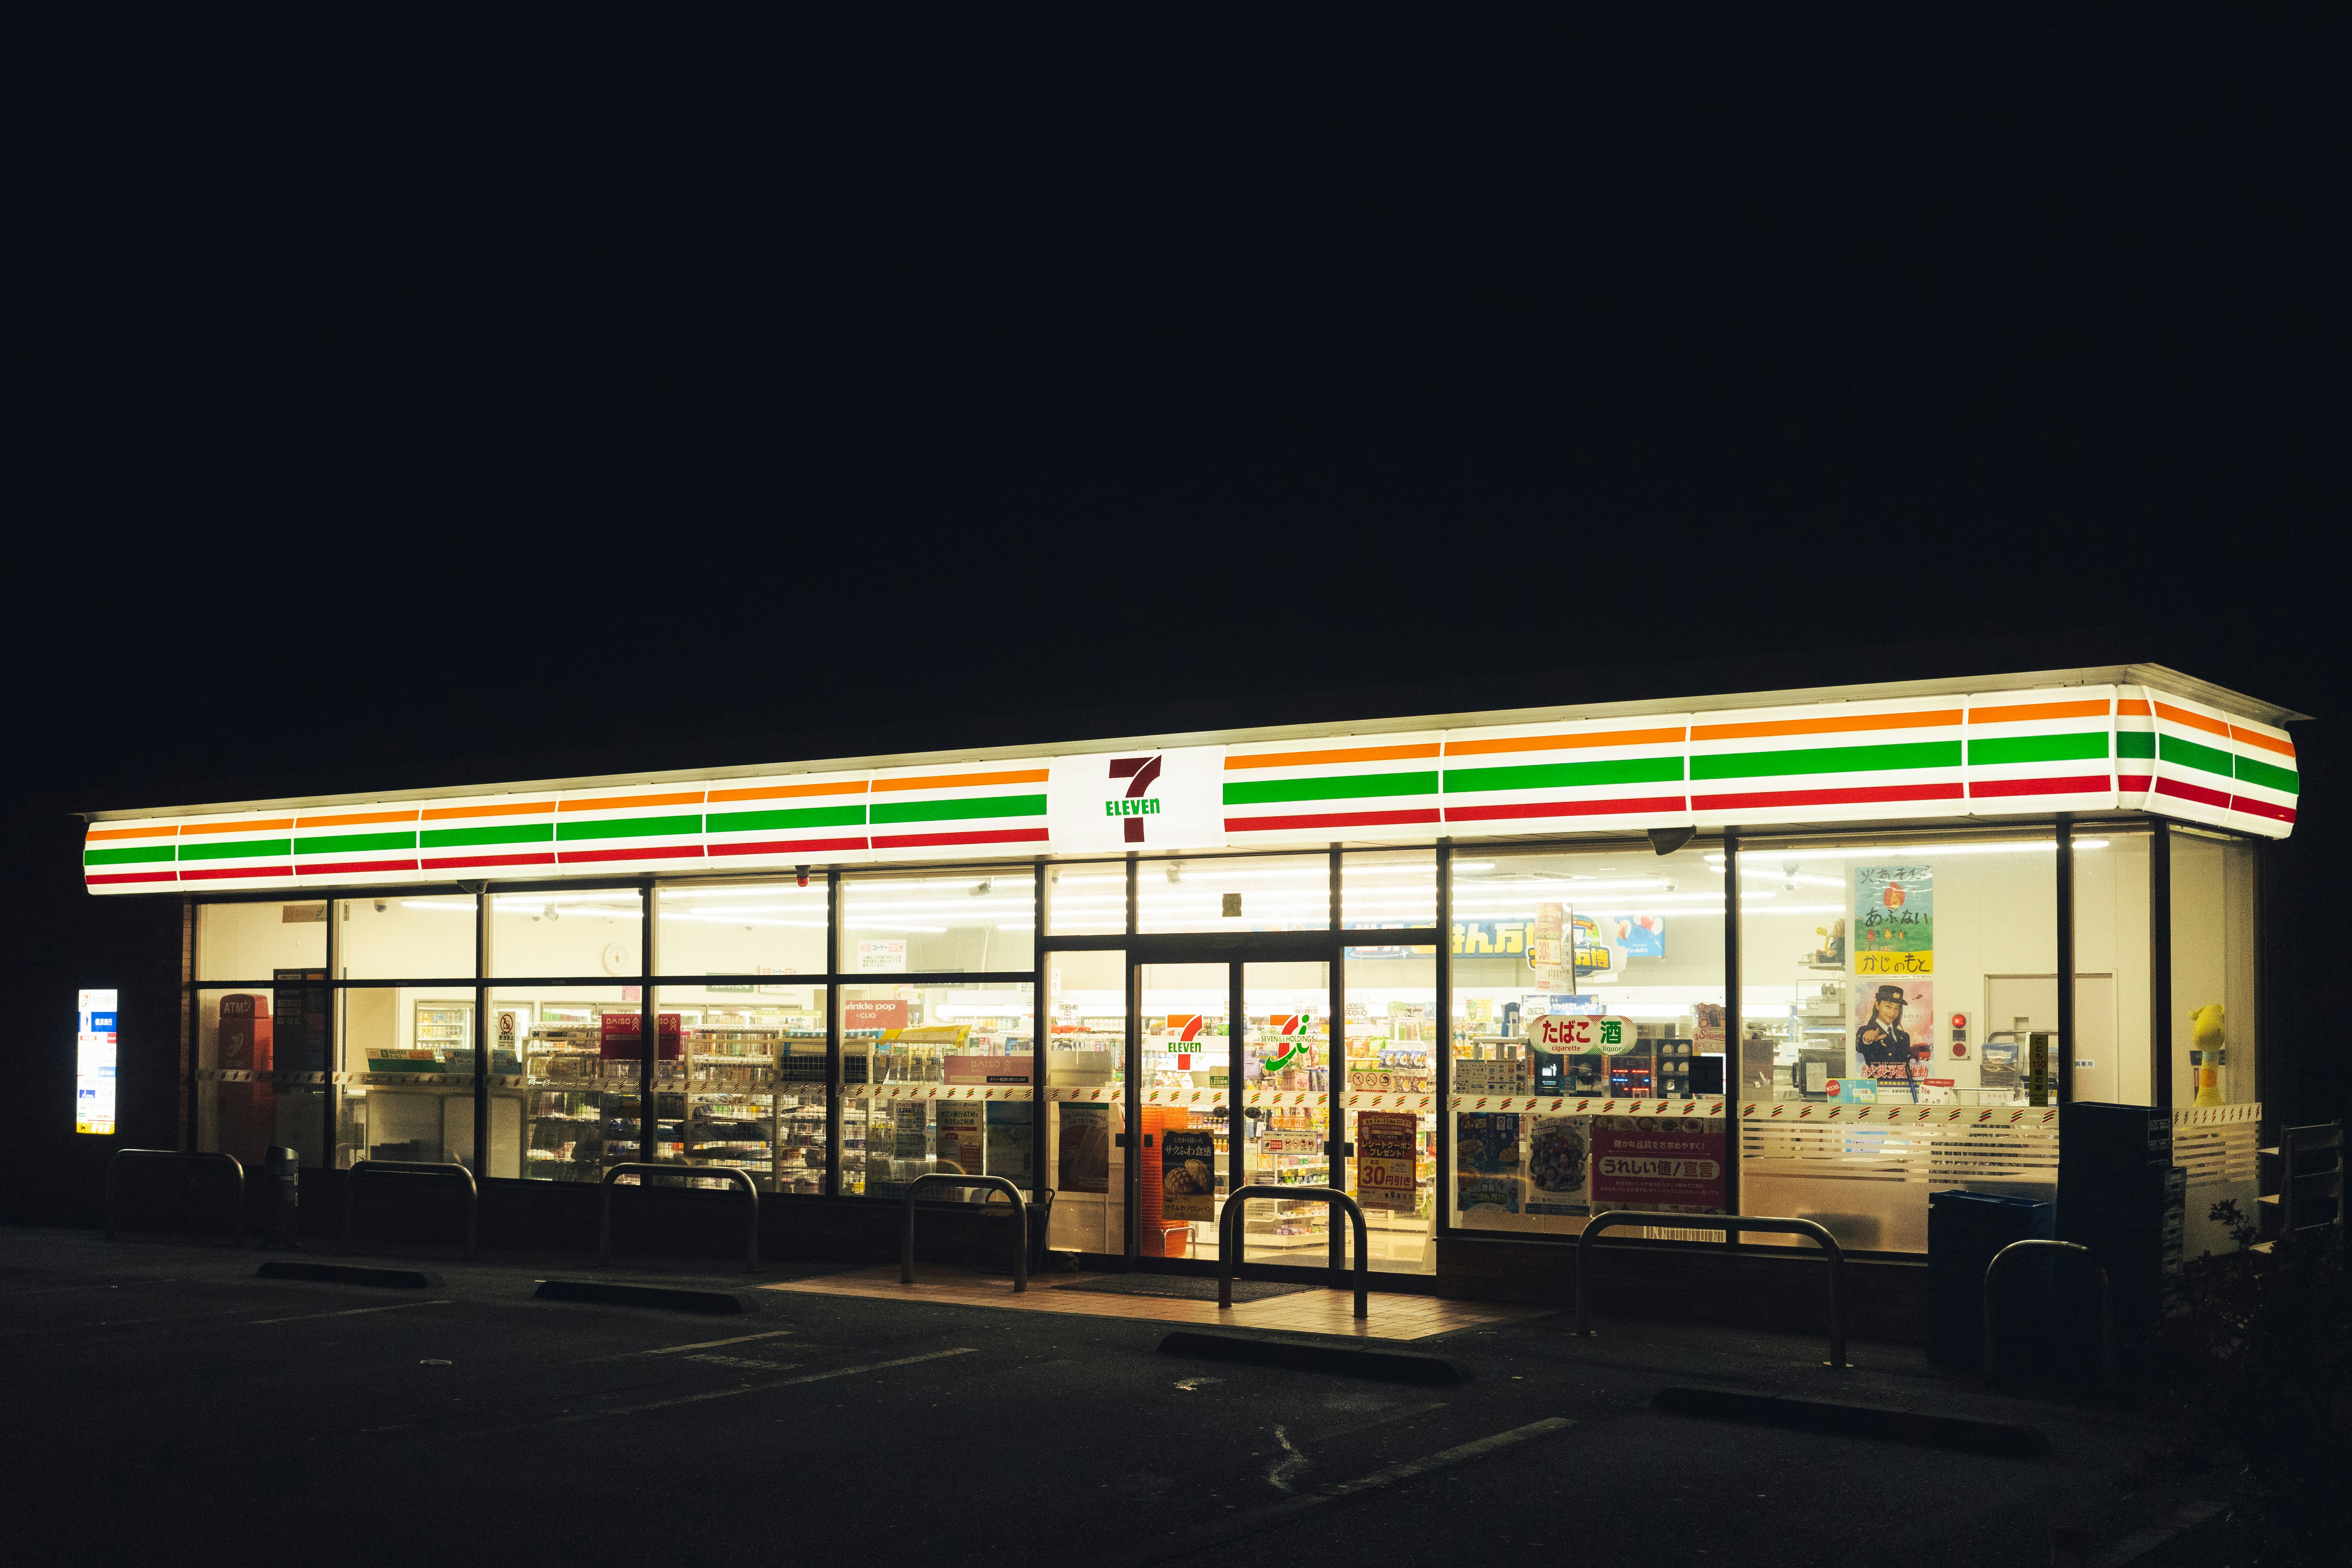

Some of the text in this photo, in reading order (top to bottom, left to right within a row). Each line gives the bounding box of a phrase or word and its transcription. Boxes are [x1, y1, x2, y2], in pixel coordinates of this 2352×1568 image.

[1866, 908, 1928, 927] あぶない
[1863, 953, 1930, 972] かじのもと
[224, 1002, 243, 1013] ATM
[845, 1002, 874, 1010] winkle
[1542, 1020, 1622, 1044] たばこ 酒
[1085, 1111, 1106, 1122] Sandwich
[1164, 1145, 1212, 1156] サクふわ食感
[1362, 1140, 1413, 1150] レシートクーポン
[1362, 1165, 1411, 1186] 30円引き
[1165, 1204, 1213, 1213] サクふわメロンパン
